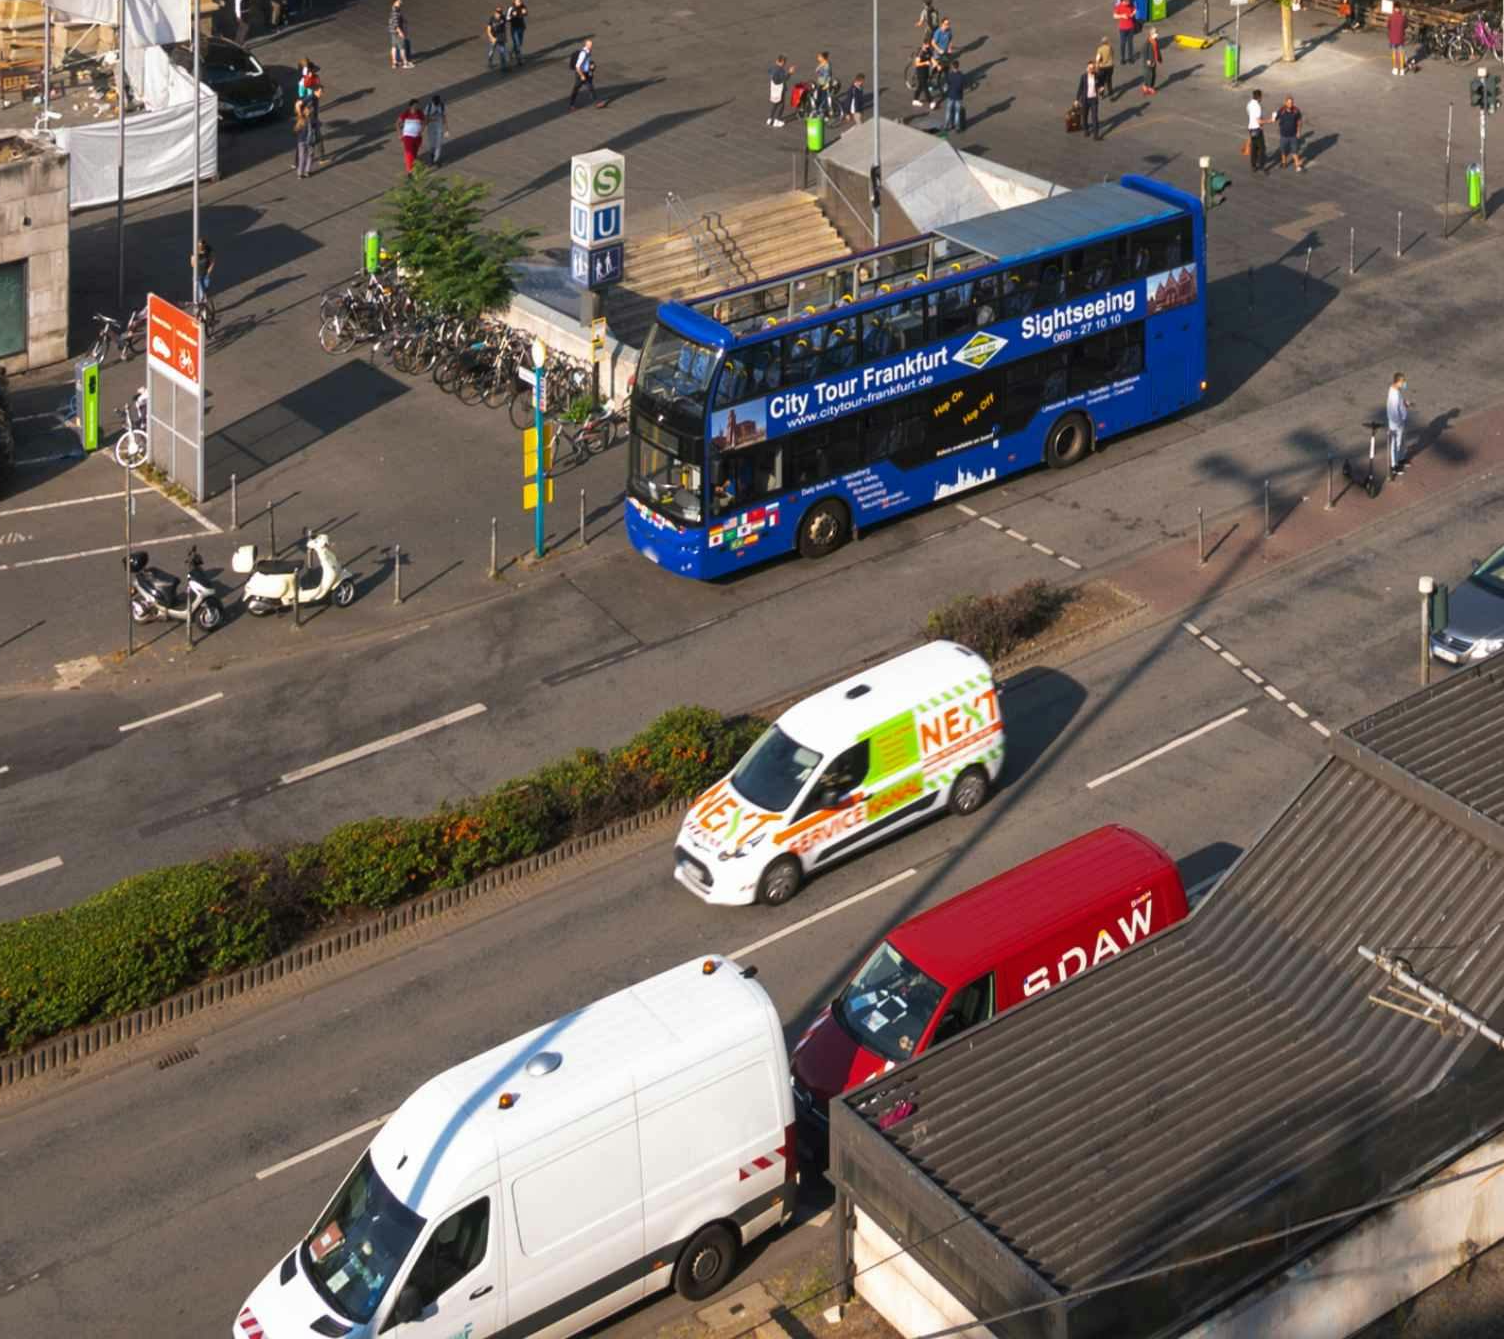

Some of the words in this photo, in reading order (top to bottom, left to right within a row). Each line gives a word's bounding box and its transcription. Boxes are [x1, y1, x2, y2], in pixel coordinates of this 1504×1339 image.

[598, 208, 615, 237] U
[1021, 290, 1136, 339] Sightseeing
[1053, 328, 1072, 344] 069
[1080, 322, 1092, 335] 27
[1095, 317, 1107, 330] 10
[1109, 314, 1121, 326] 10
[770, 391, 808, 419] City
[814, 376, 858, 405] Tour
[863, 346, 948, 390] Frankfurt
[786, 374, 933, 429] www.citytour-frankfurt.de
[920, 688, 997, 754] NEXT
[689, 778, 784, 847] NEXT
[788, 806, 866, 855] SERVICE
